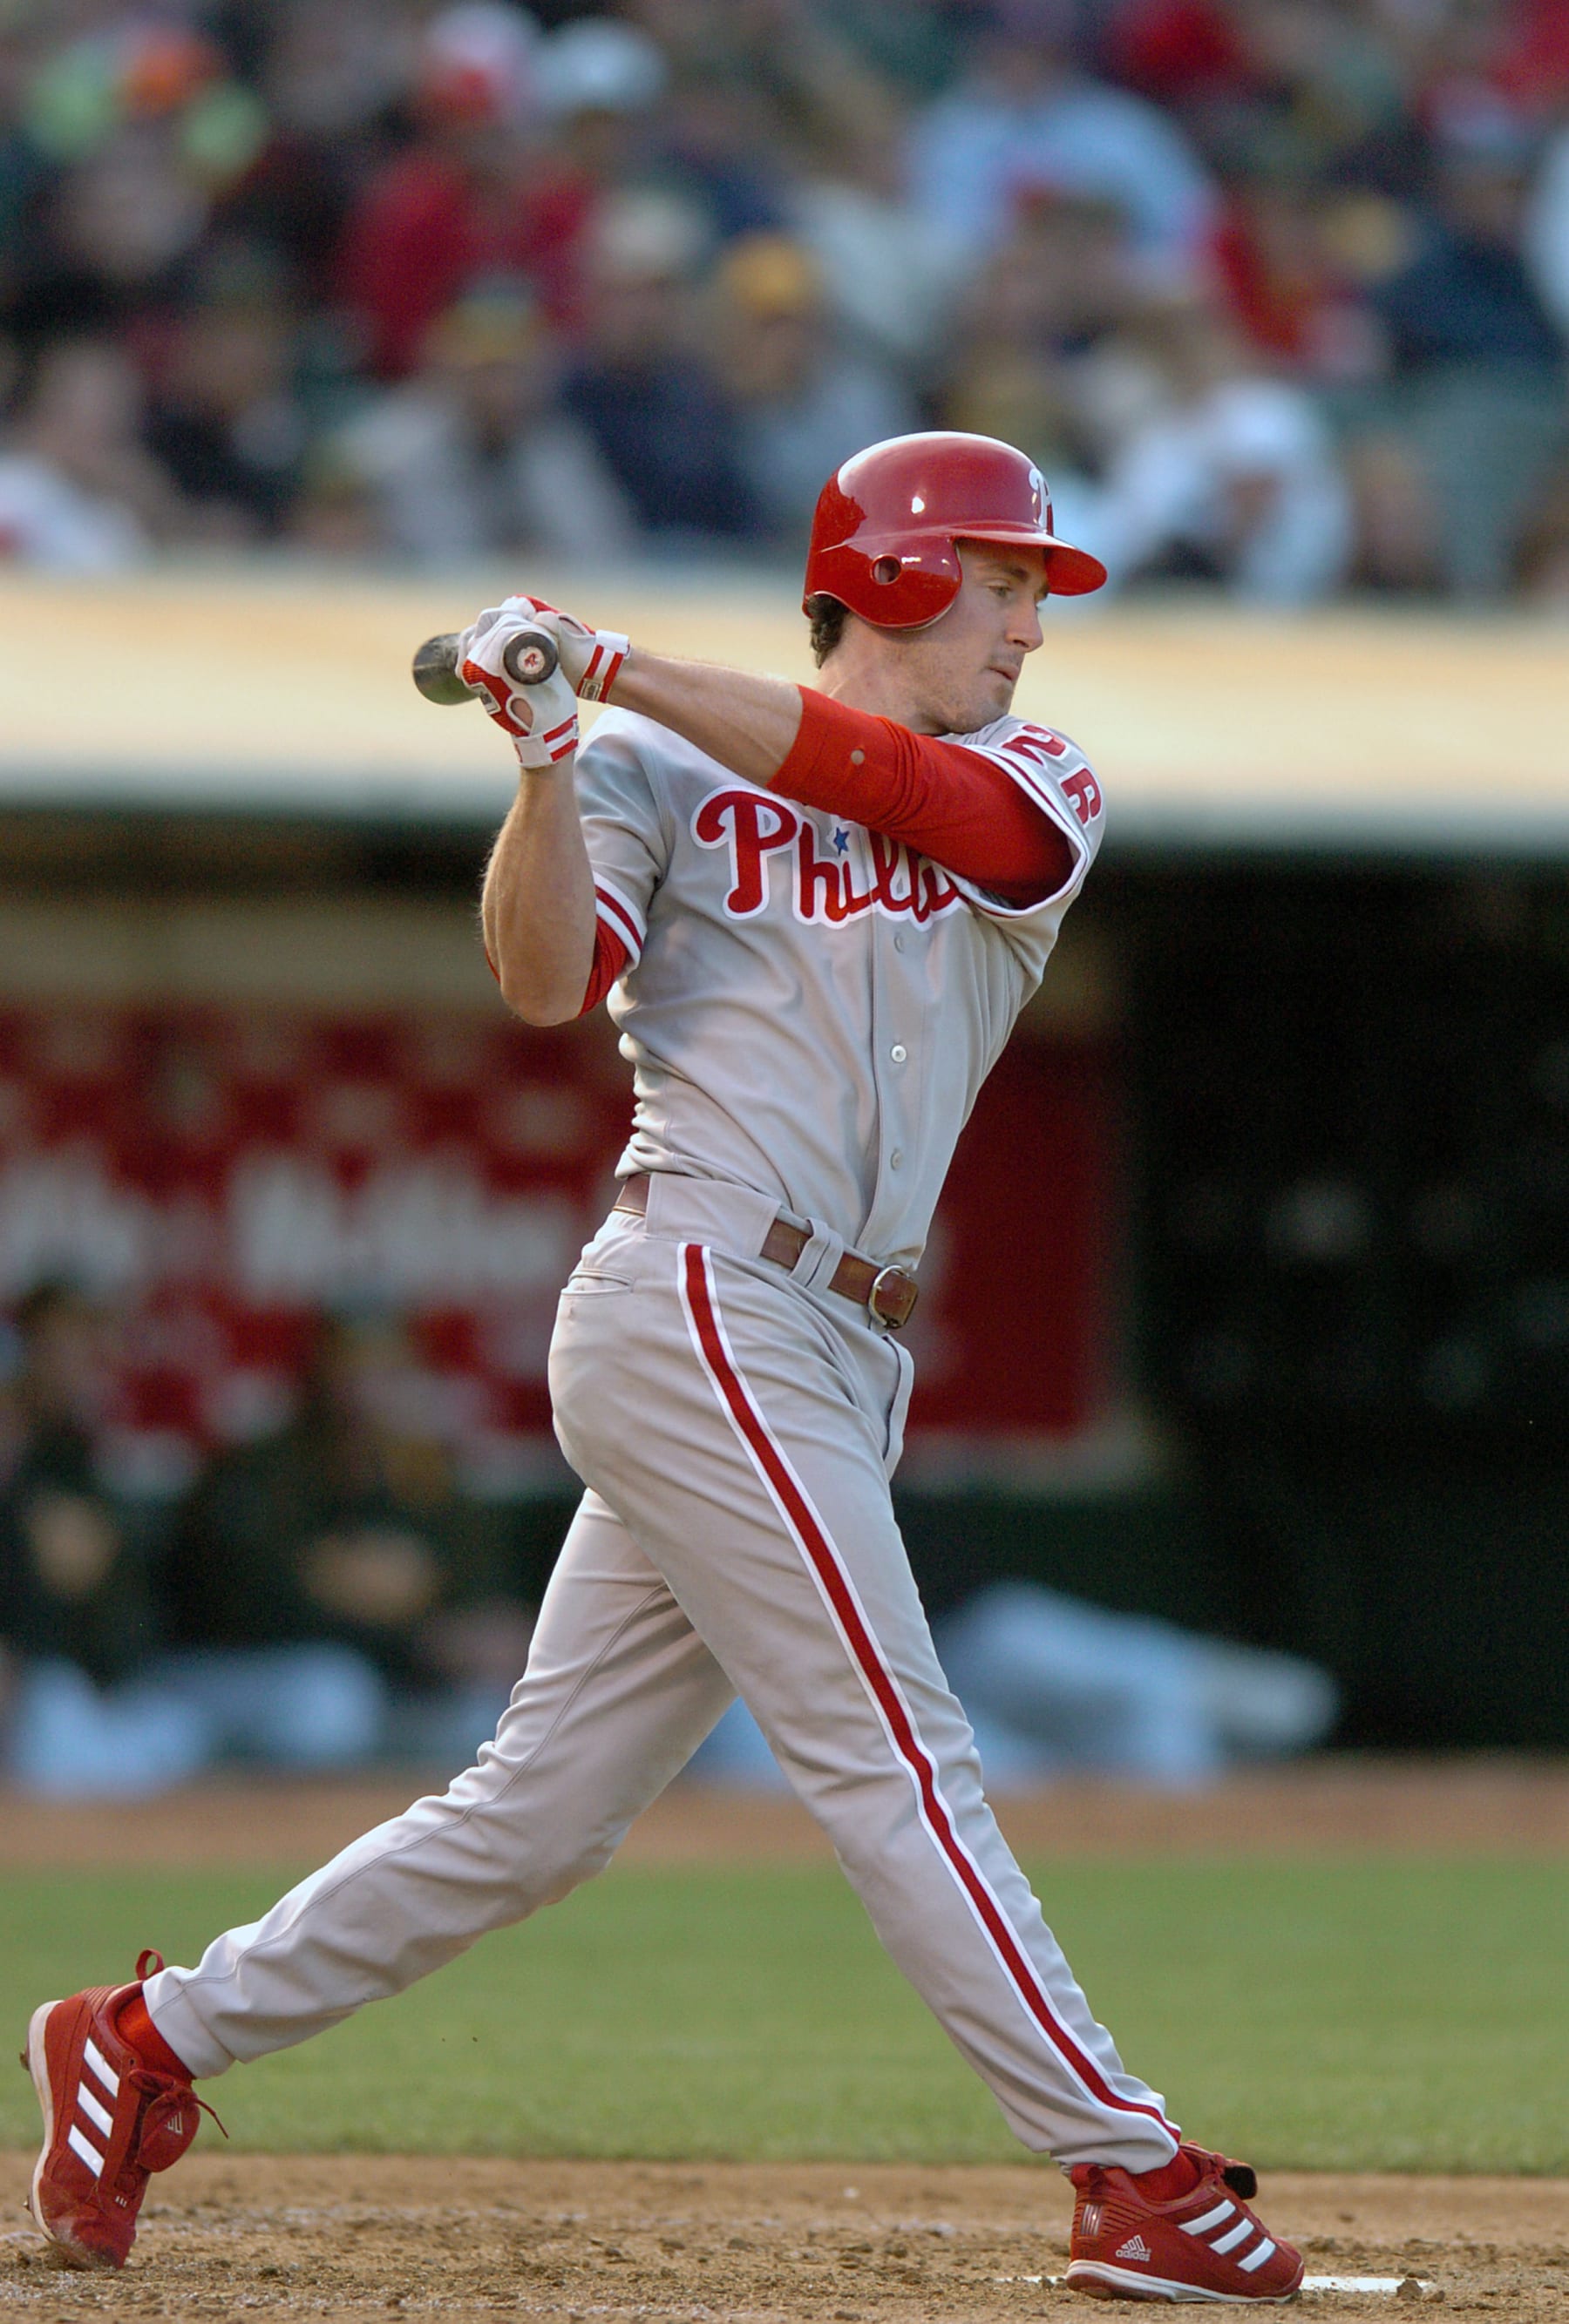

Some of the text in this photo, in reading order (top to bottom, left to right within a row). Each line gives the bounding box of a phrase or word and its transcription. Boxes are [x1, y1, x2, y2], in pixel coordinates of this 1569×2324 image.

[1029, 467, 1052, 529] P
[692, 787, 961, 929] Philli
[1116, 2248, 1150, 2262] adidas
